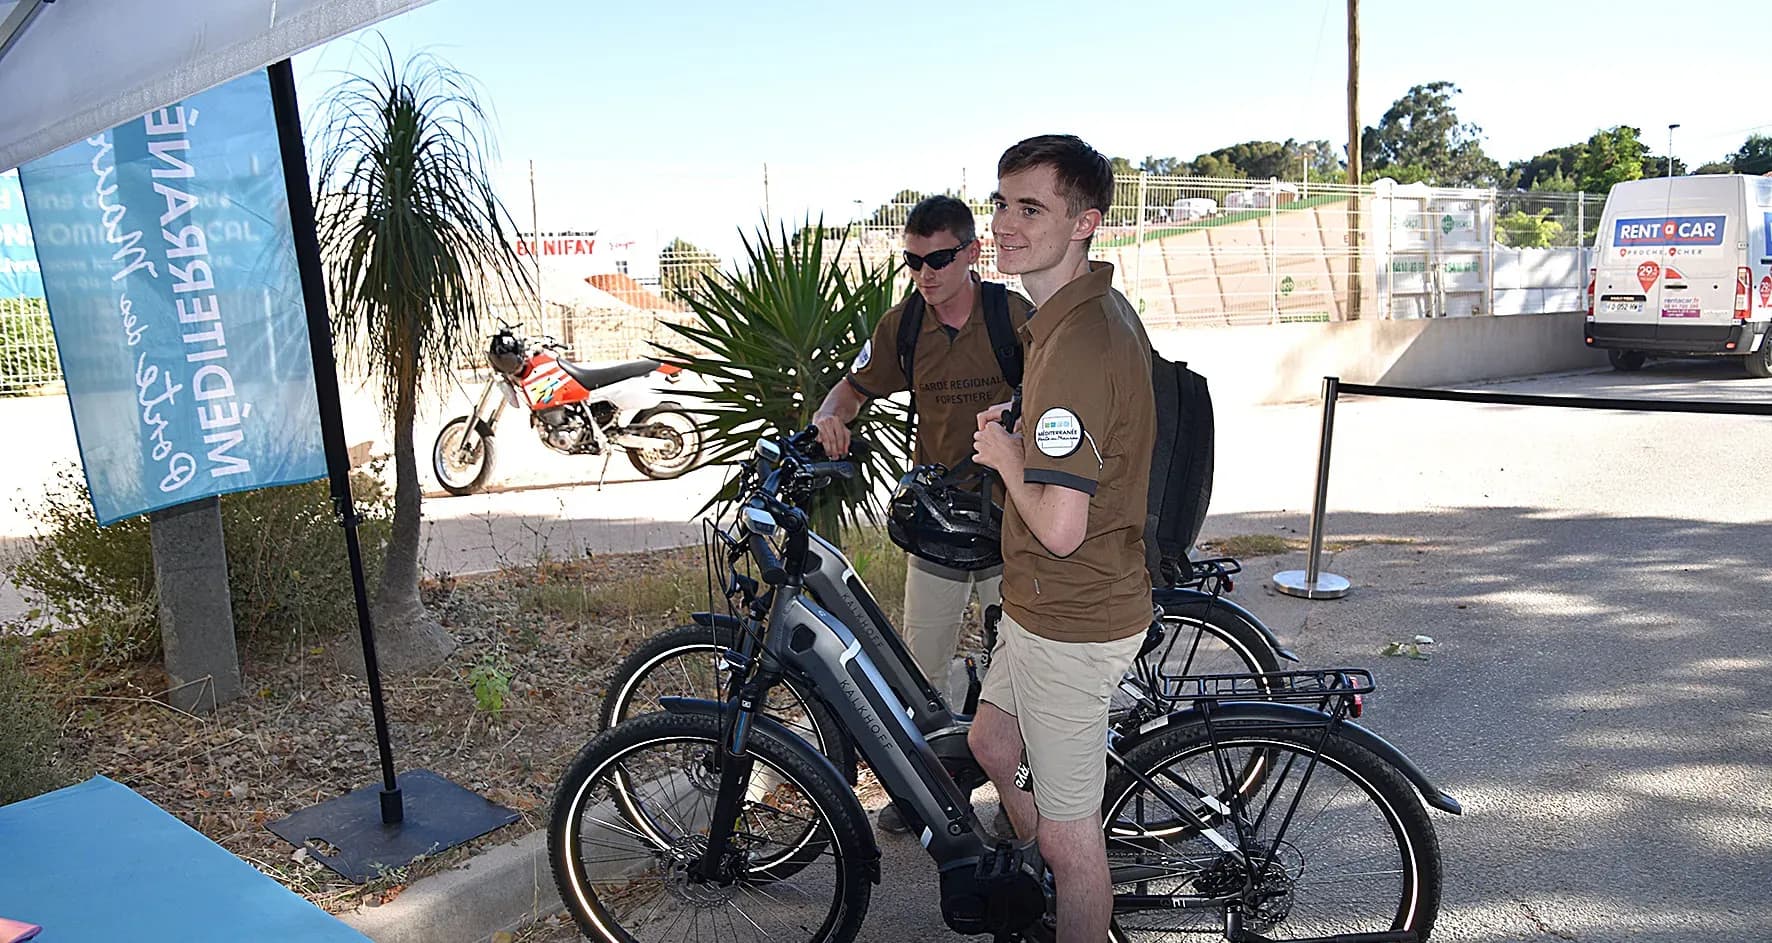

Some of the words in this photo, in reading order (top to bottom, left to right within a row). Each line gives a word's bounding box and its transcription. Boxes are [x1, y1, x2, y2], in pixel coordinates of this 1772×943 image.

[1620, 223, 1661, 239] RENT
[1678, 221, 1716, 238] CAR
[919, 380, 949, 392] GARDE
[935, 391, 993, 405] FORESTIERE
[841, 592, 885, 648] KALKHOFF
[840, 680, 893, 749] KALKHOFF
